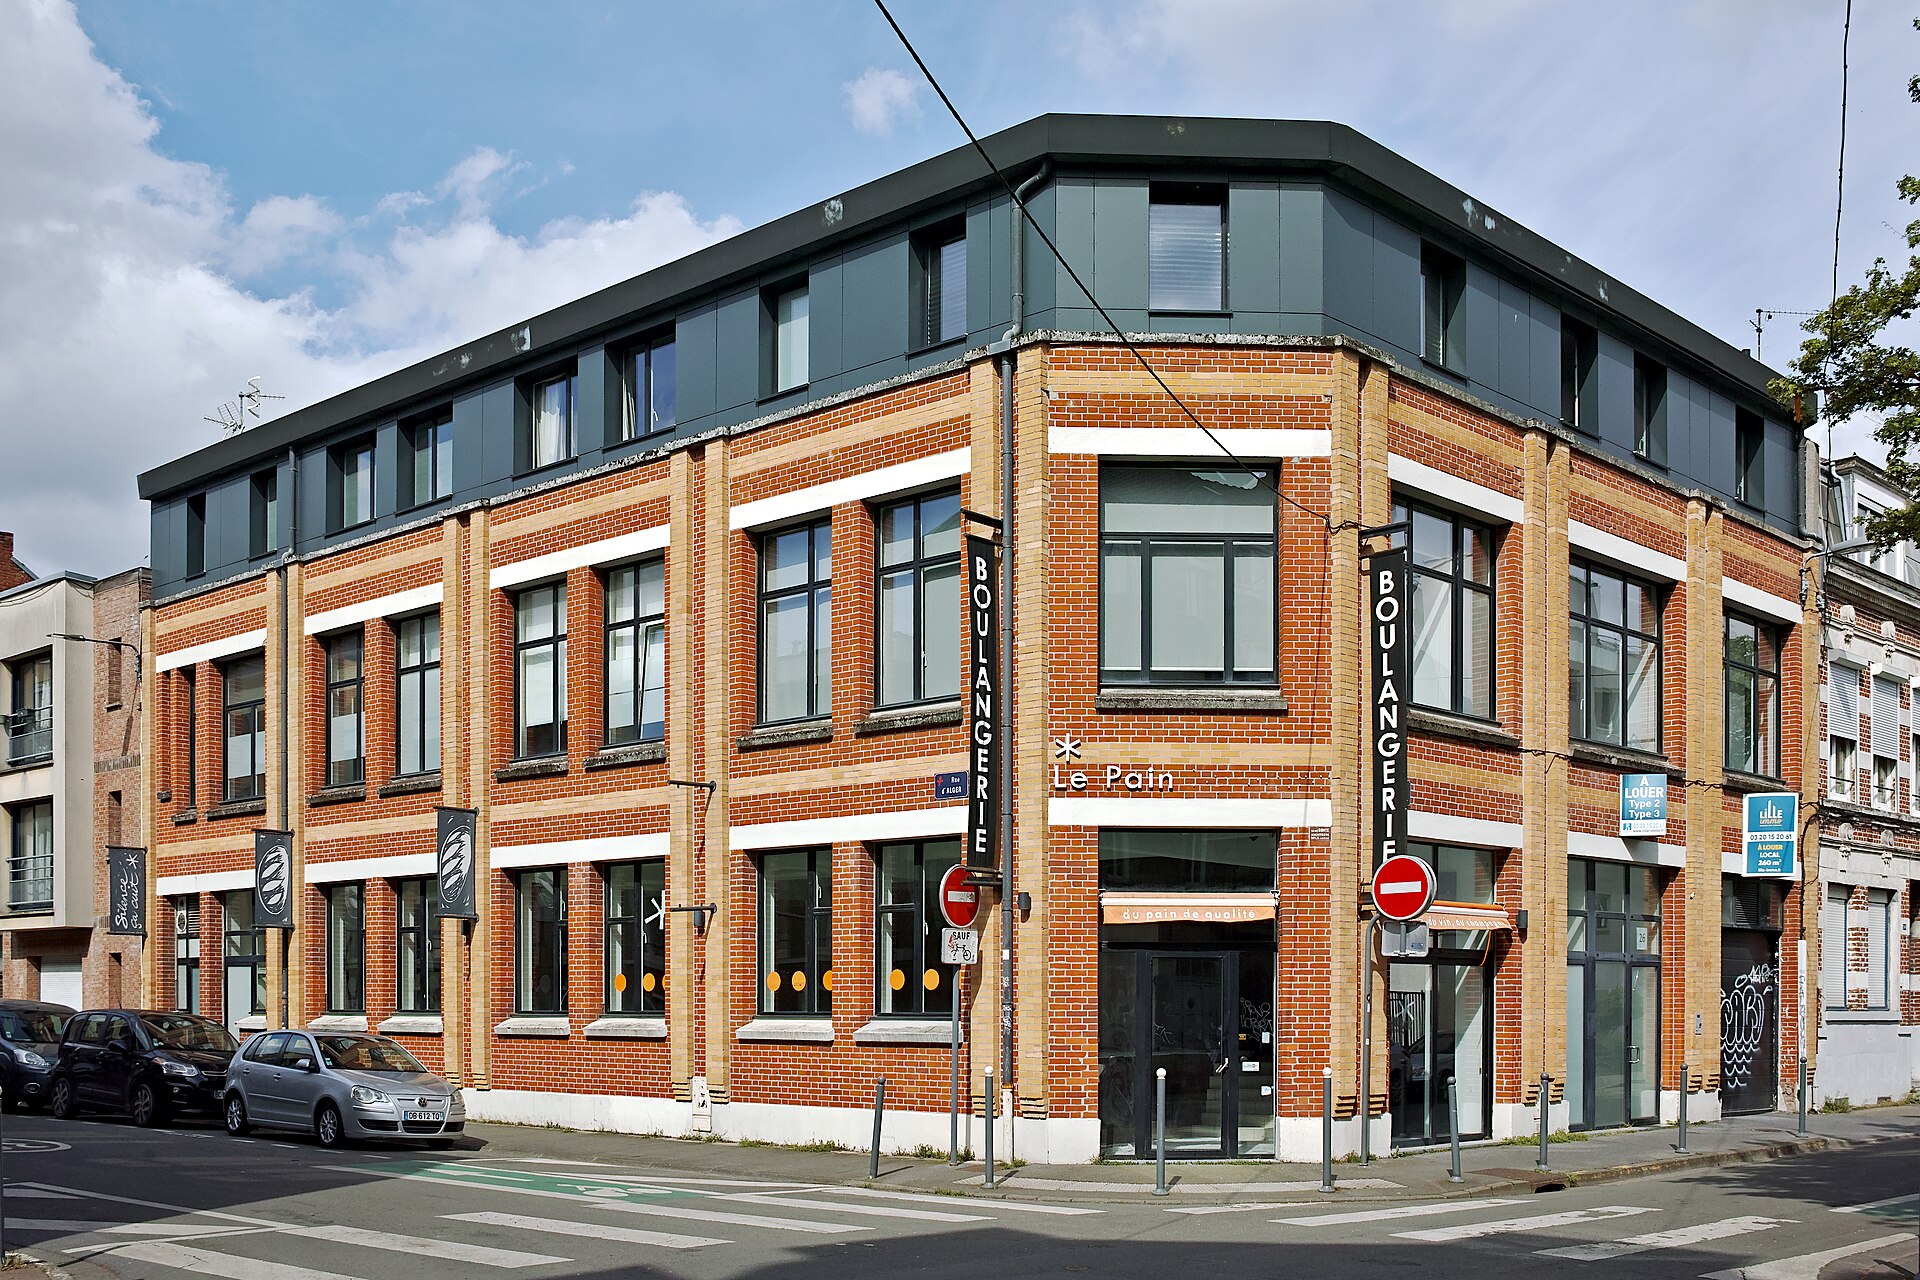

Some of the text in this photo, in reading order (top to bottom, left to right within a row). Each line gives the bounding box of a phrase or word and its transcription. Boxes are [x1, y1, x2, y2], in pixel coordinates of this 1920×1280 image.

[973, 556, 993, 853] BOULANGERIE
[1375, 569, 1401, 864] BOULANGERIE
[950, 776, 961, 784] Rue
[1054, 764, 1174, 791] Le Pain
[1625, 787, 1664, 799] LOUER
[1629, 799, 1661, 809] Type 2
[1629, 809, 1661, 820] Type 3
[128, 872, 139, 909] cuit
[115, 867, 129, 930] Silence
[1122, 907, 1256, 921] du pain de qualité
[952, 931, 970, 940] SAUF
[418, 1112, 430, 1120] 612
